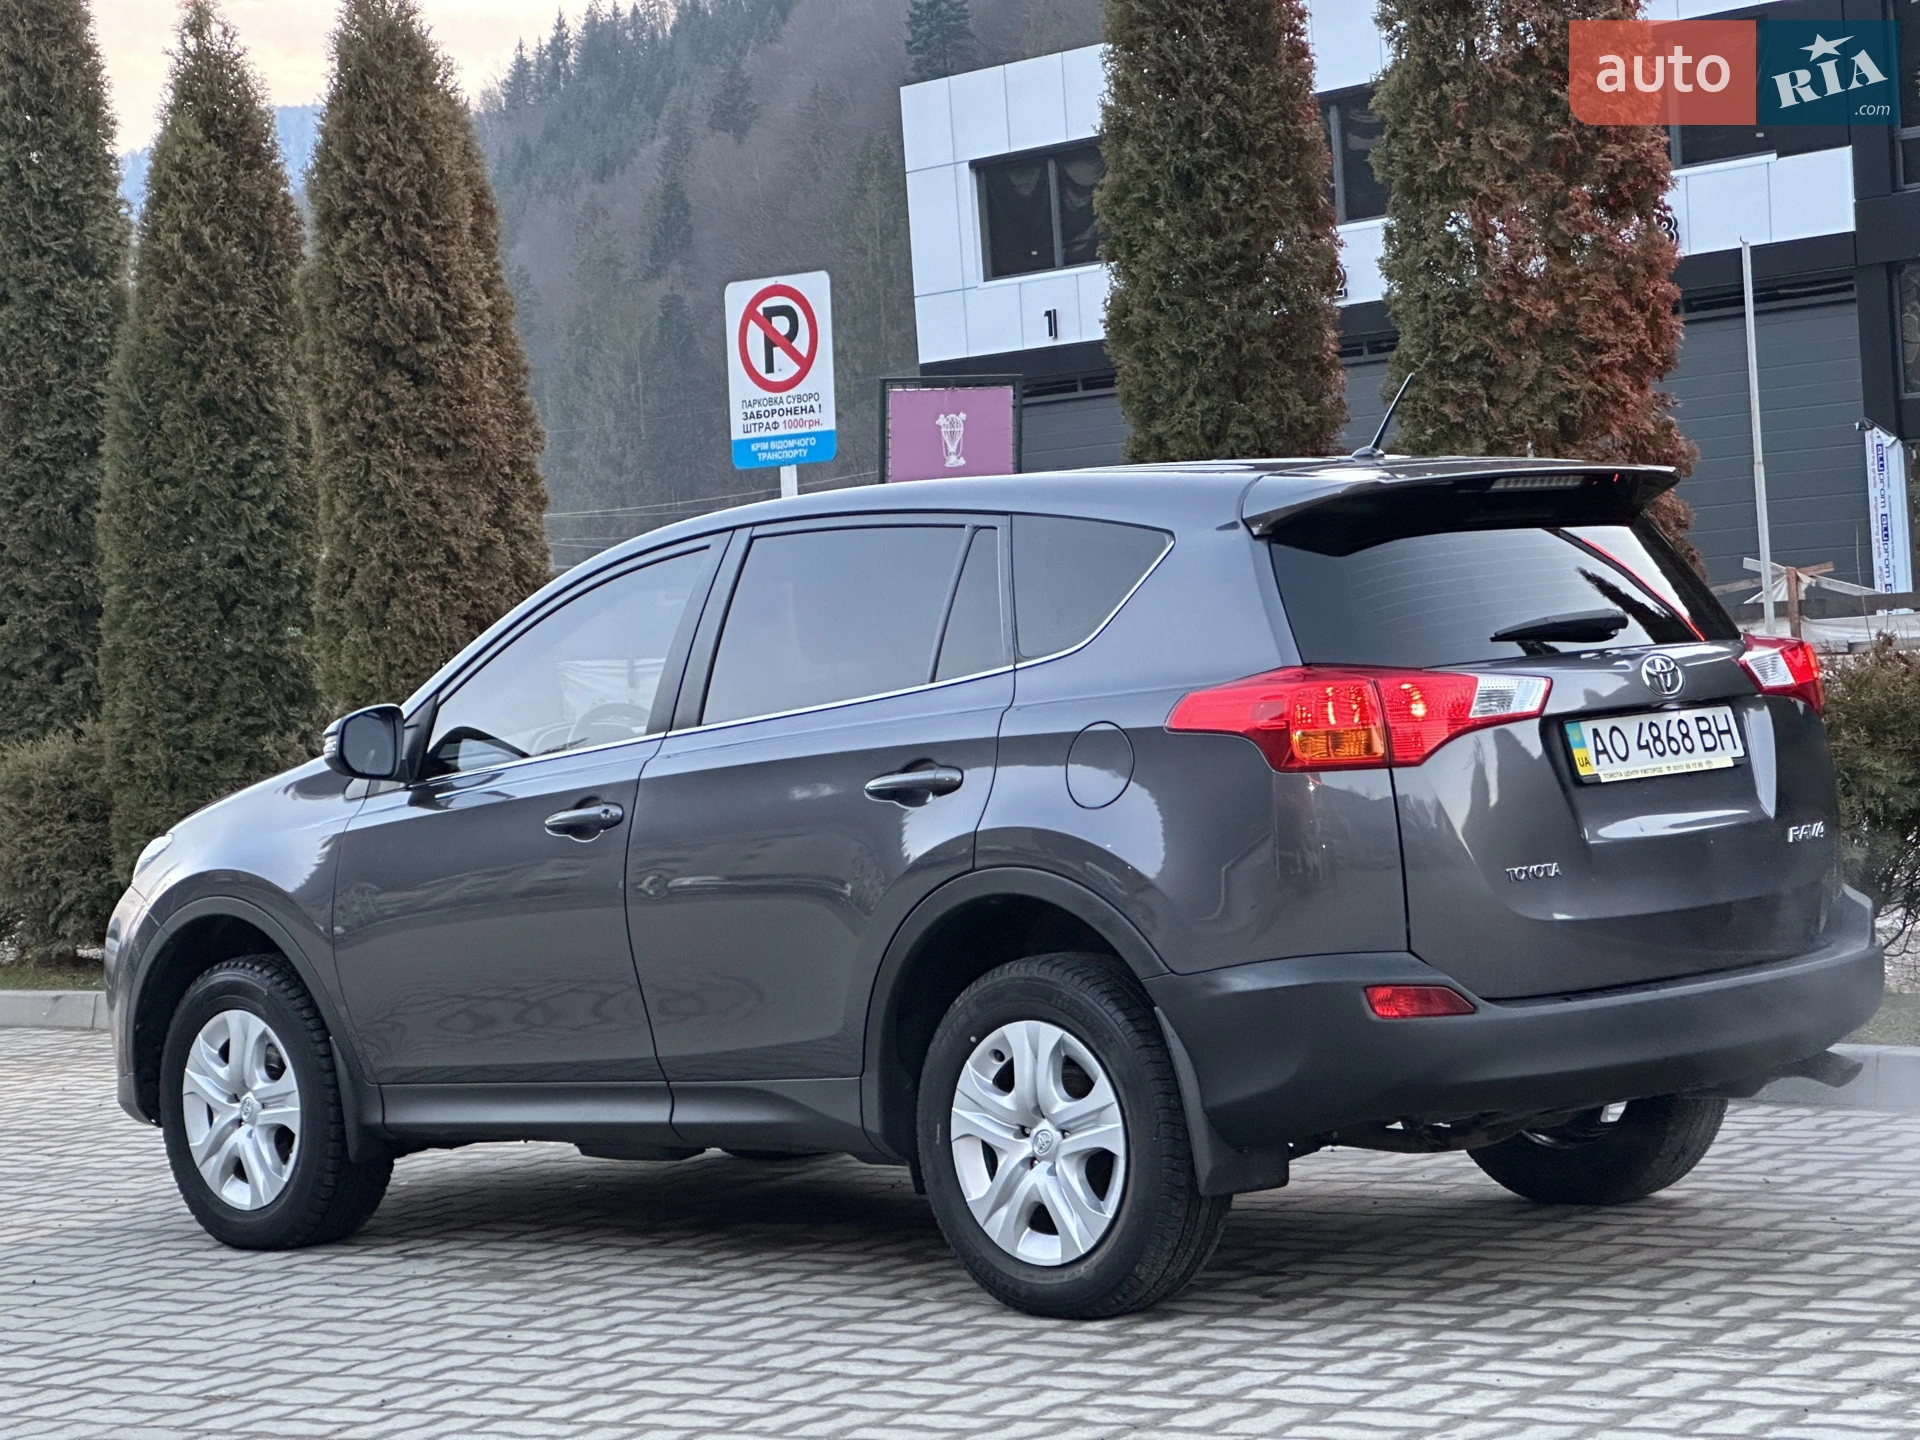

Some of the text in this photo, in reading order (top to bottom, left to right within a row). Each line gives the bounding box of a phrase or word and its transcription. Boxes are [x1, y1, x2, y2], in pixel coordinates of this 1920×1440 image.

[1044, 308, 1058, 339] 1
[742, 392, 820, 409] ПАРКОВКА СУВОРО
[742, 405, 815, 421] ЗАБОРОНЕНА
[743, 418, 823, 433] ШТРАФ 1000грн.
[751, 437, 816, 452] КРІМ ВІДОМЧОГО
[757, 449, 808, 461] ТРАНСПОРТУ
[1592, 713, 1737, 765] AO 4868 BH
[1578, 757, 1591, 768] UA
[1505, 863, 1562, 881] TOYOTA
